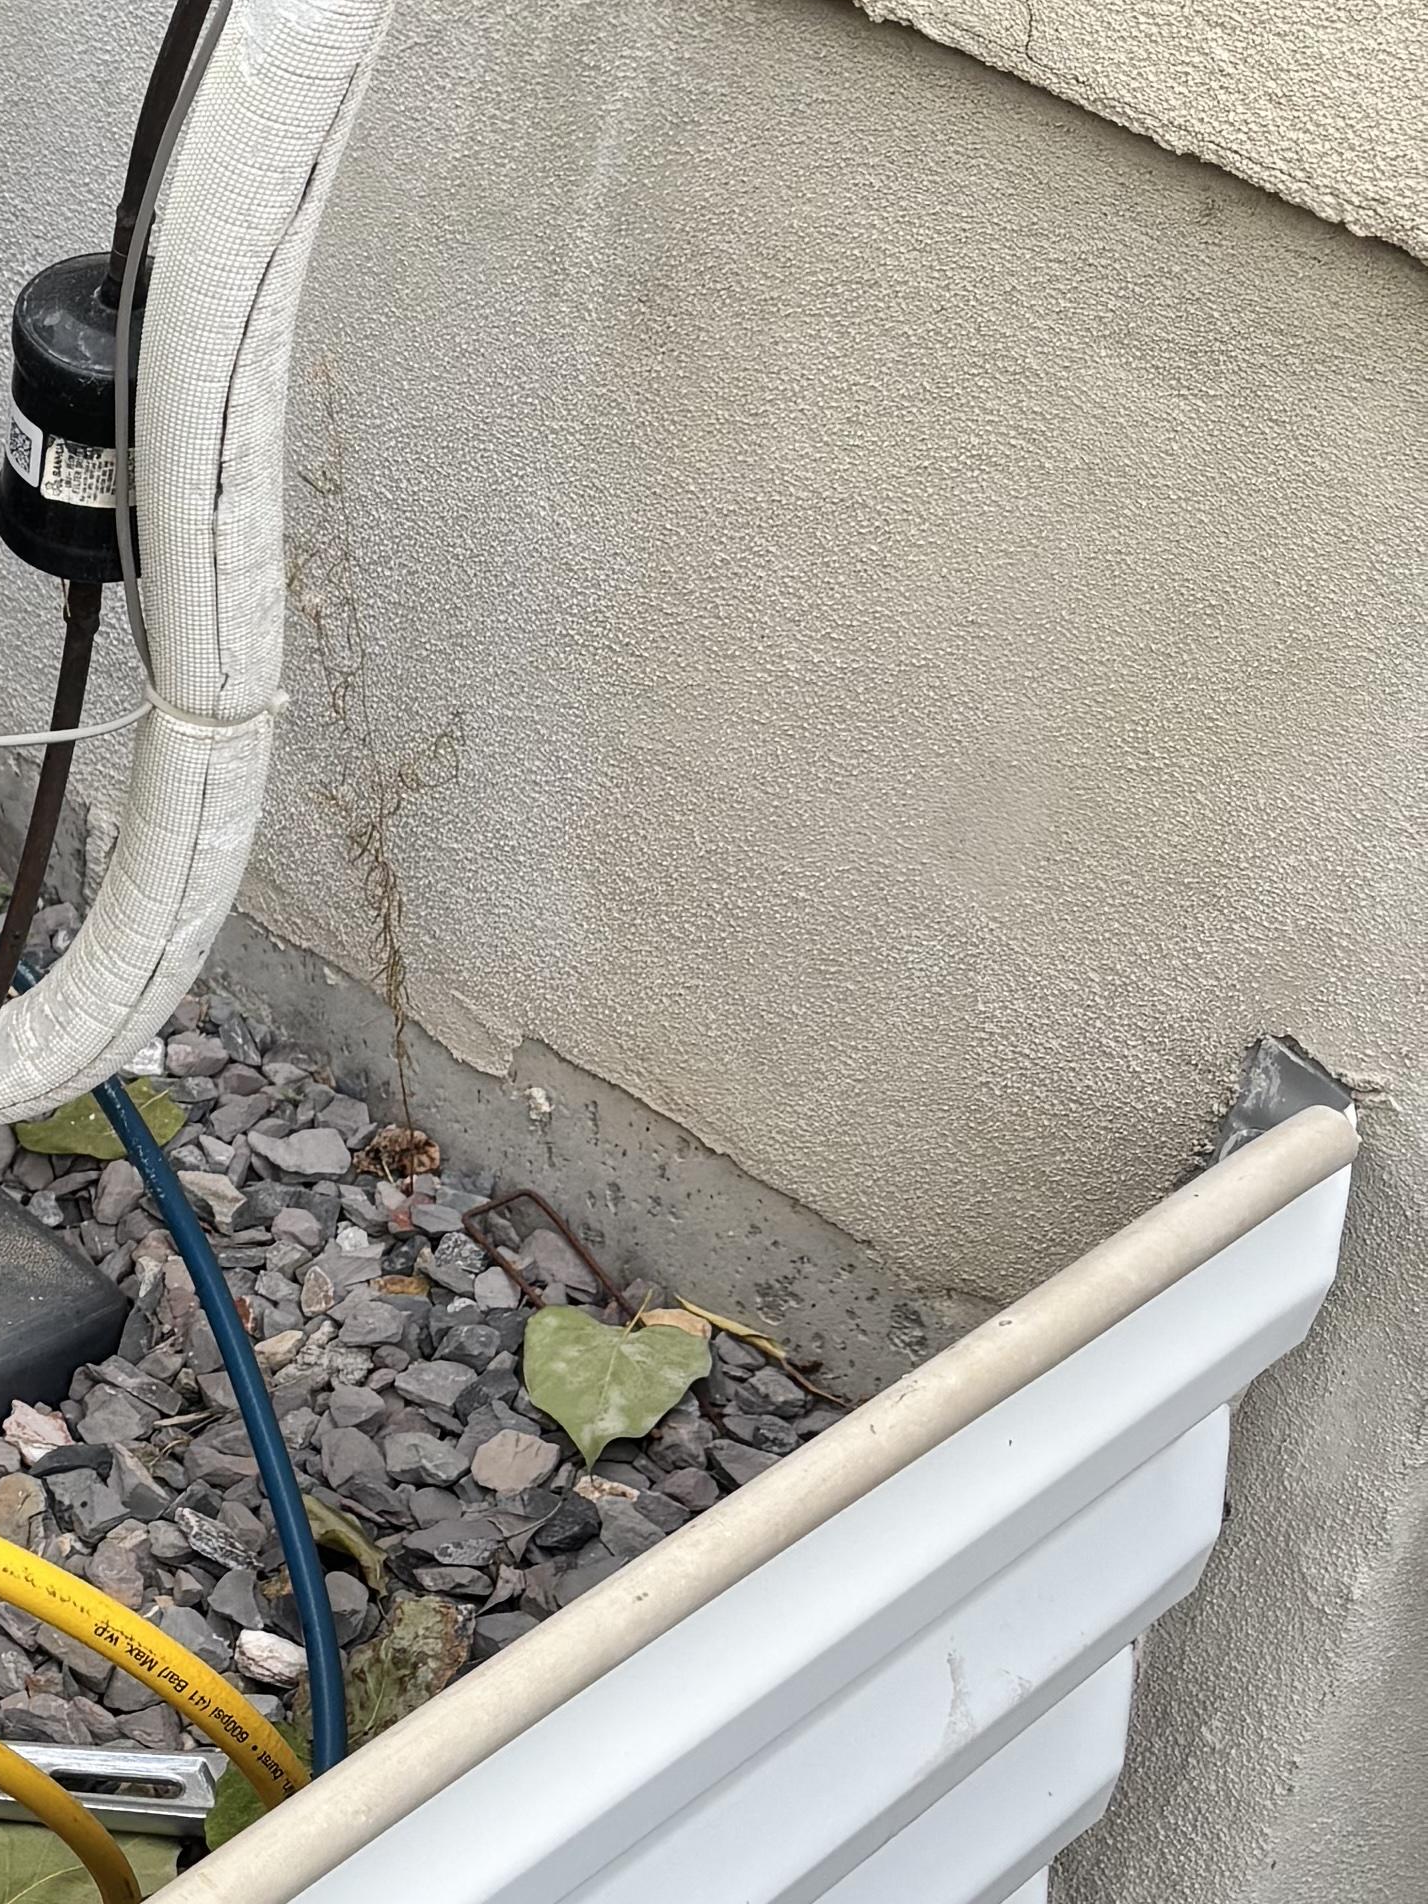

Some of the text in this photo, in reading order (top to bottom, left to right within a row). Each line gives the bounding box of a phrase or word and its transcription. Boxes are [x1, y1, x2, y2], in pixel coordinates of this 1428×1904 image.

[126, 1644, 159, 1672] Max.
[158, 1666, 189, 1693] Bar)
[189, 1689, 211, 1712] (41
[210, 1706, 249, 1744] 600psi
